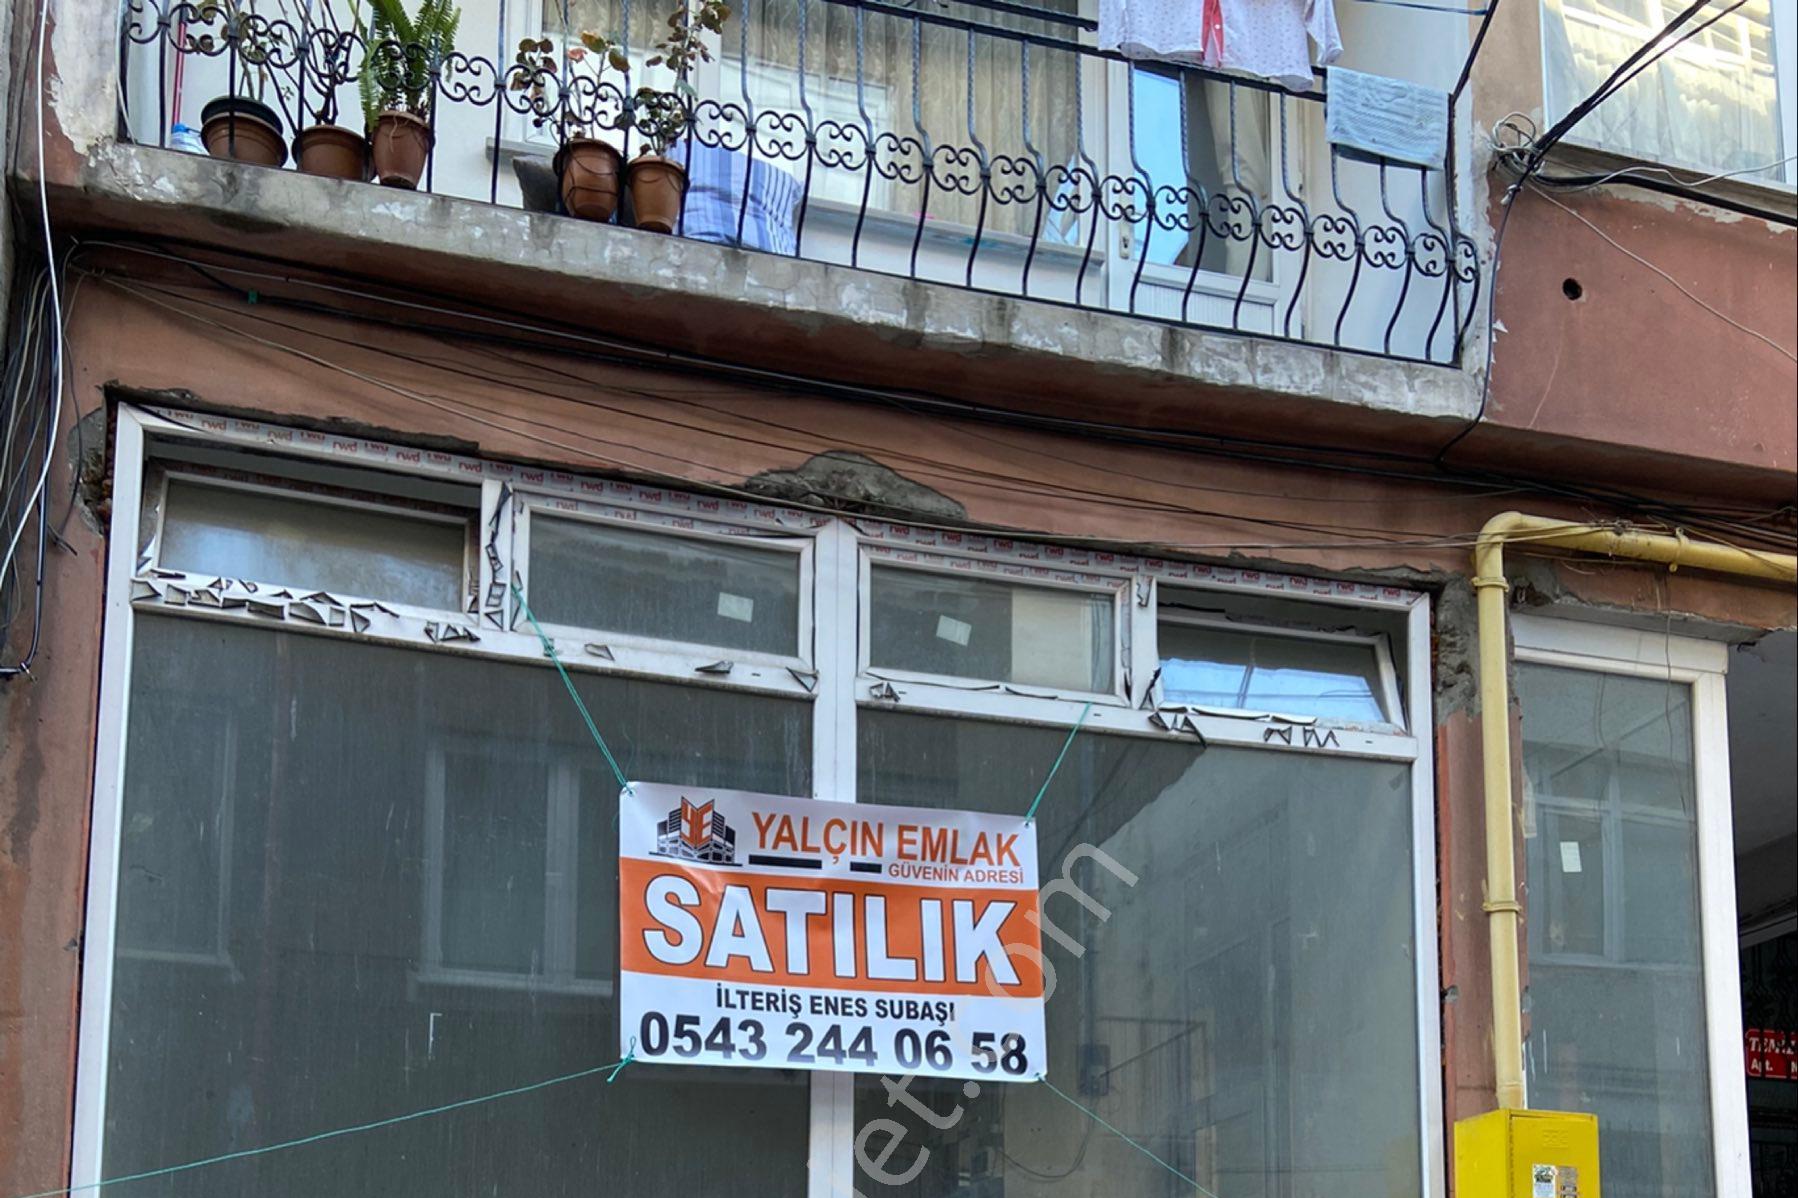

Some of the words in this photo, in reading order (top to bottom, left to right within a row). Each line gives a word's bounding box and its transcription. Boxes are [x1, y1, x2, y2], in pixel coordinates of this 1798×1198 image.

[752, 812, 884, 864] YALÇIN
[899, 825, 1021, 867] EMLAK
[888, 862, 960, 883] GÜVENİN
[963, 867, 1024, 884] ADRESİ
[642, 874, 1022, 986] SATILIK
[716, 982, 802, 1016] İLTERİŞ
[809, 995, 868, 1018] ENES
[874, 999, 955, 1026] SUBAŞI
[641, 1011, 767, 1060] 0543
[786, 1023, 878, 1068] 244
[895, 1027, 953, 1072] 06
[971, 1033, 1028, 1075] 58
